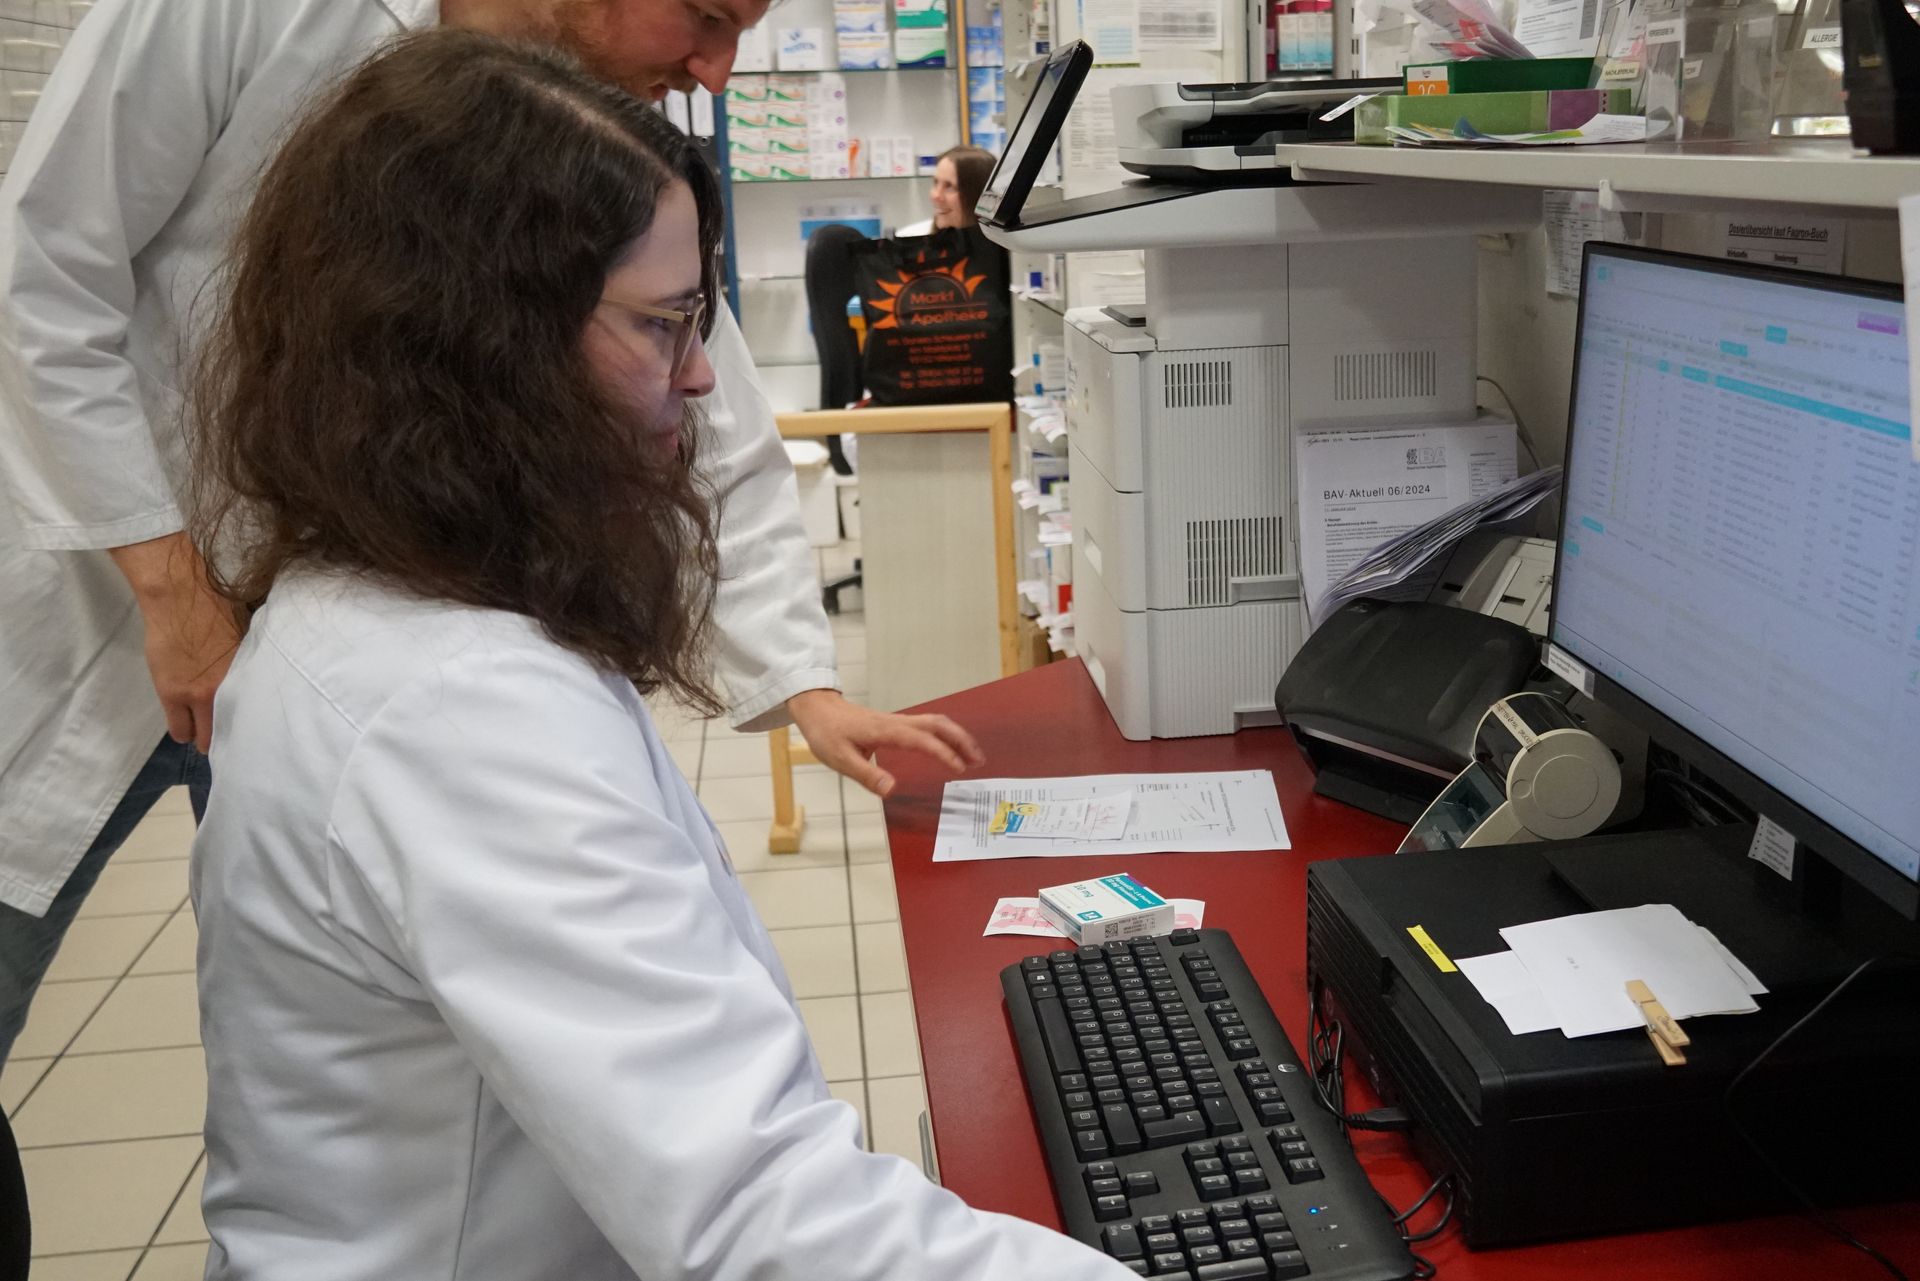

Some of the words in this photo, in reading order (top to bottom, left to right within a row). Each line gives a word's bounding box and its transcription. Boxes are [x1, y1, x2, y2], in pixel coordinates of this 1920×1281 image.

[1810, 34, 1838, 43] ALLERGIE
[911, 291, 954, 304] Markt
[912, 310, 988, 326] Apotheke
[1324, 488, 1384, 500] BAV-Aktuell
[1388, 484, 1431, 496] 06/2024
